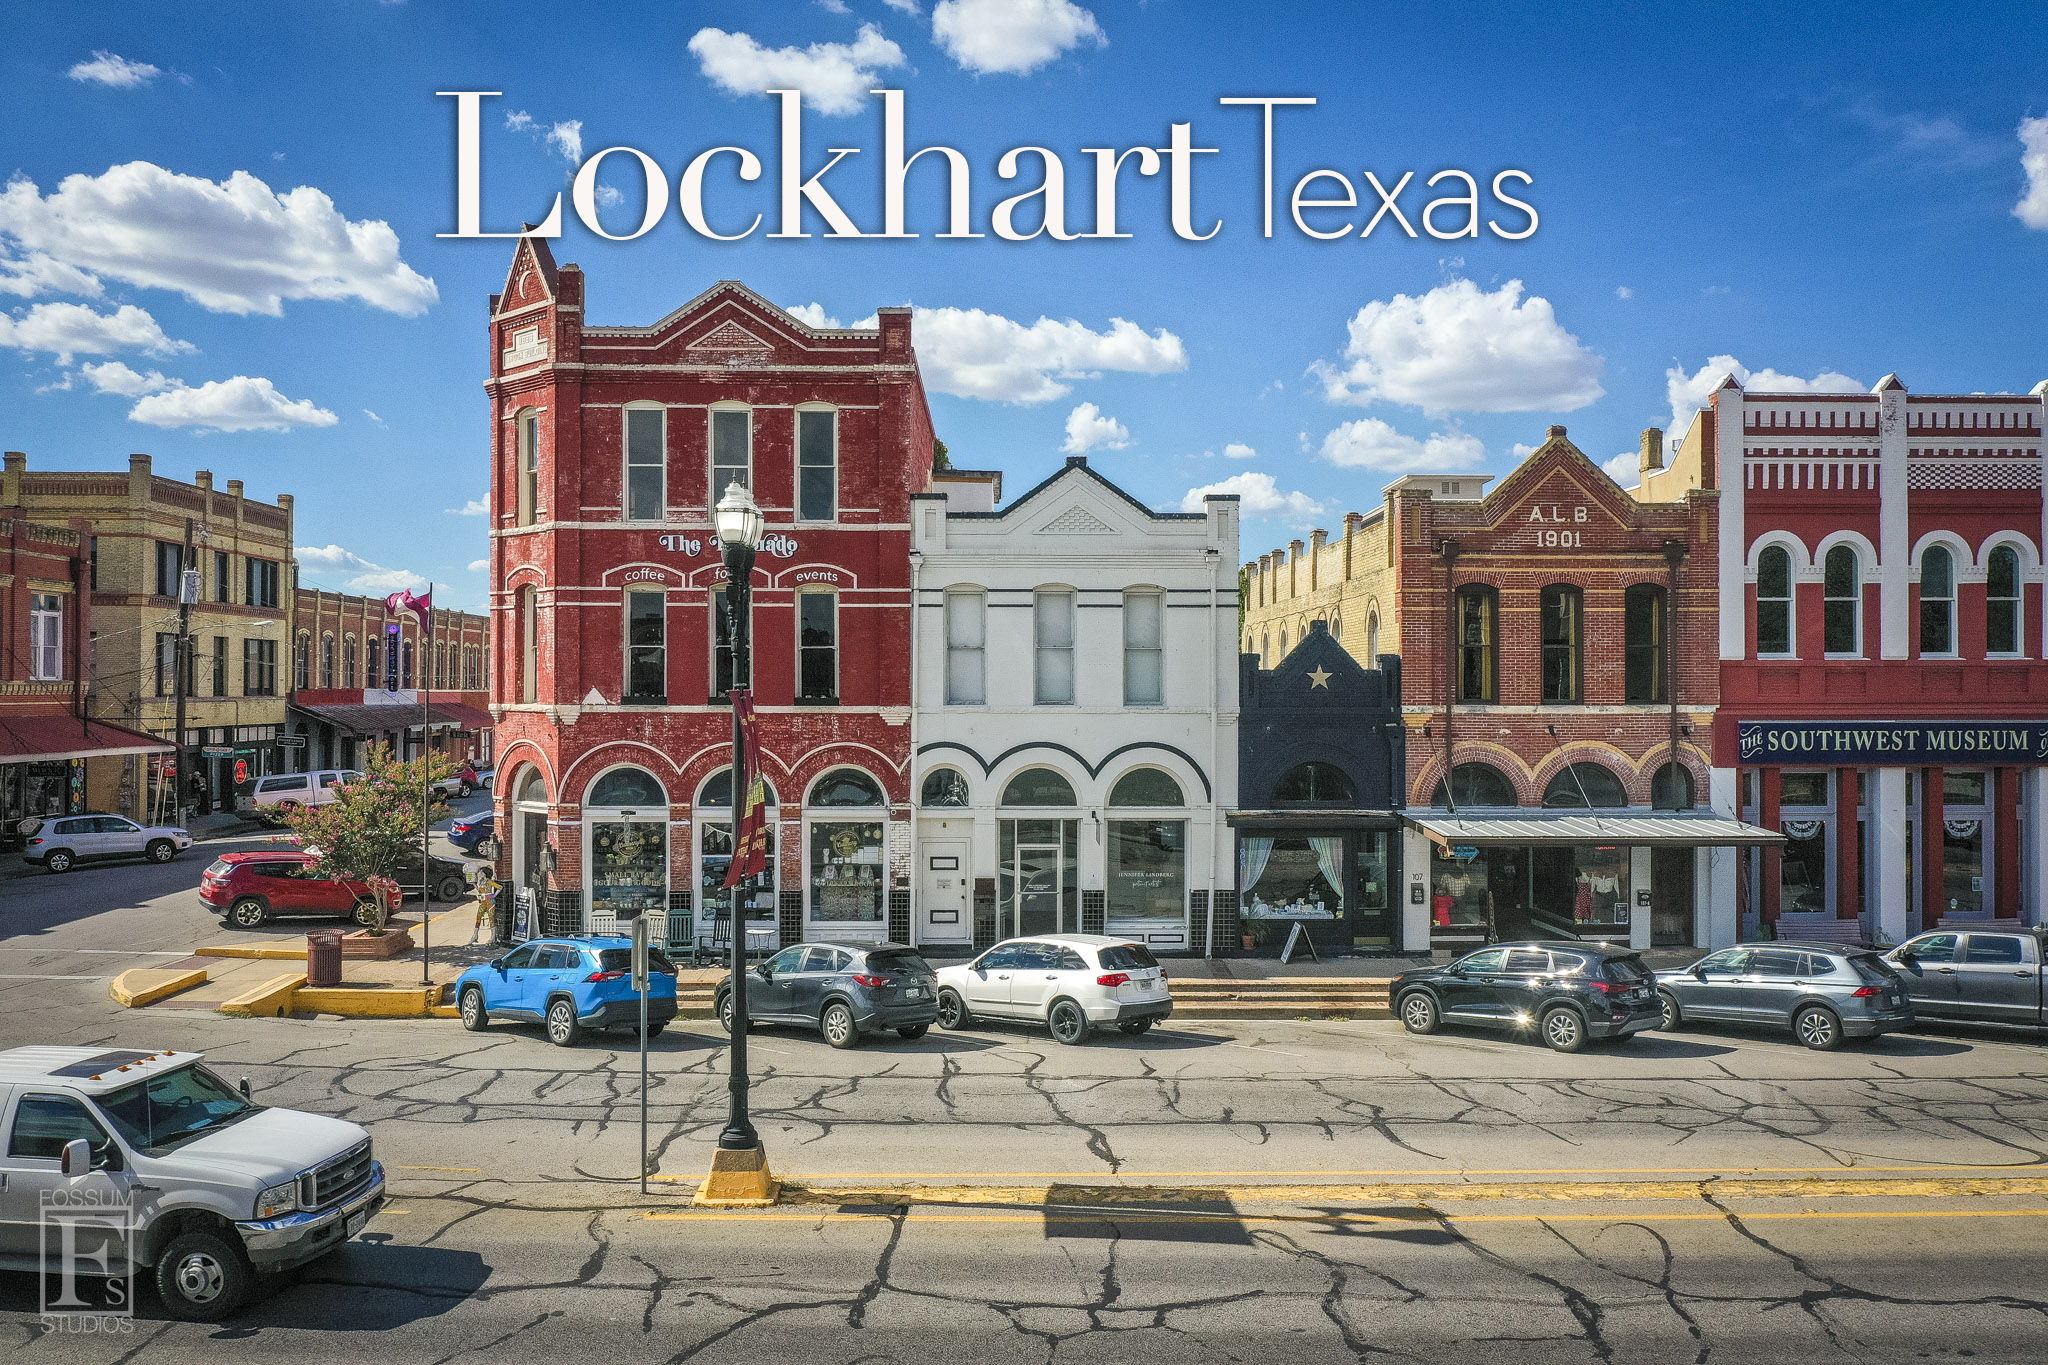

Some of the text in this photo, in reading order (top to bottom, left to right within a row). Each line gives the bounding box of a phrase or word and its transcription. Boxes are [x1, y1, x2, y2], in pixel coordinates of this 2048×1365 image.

[659, 535, 701, 557] The
[1537, 530, 1582, 547] 1901
[625, 567, 665, 580] coffee
[796, 570, 839, 582] events
[1740, 731, 1763, 751] THE
[1767, 730, 1919, 751] SOUTHWEST
[1926, 730, 2029, 751] MUSEUM
[1412, 873, 1424, 881] 107
